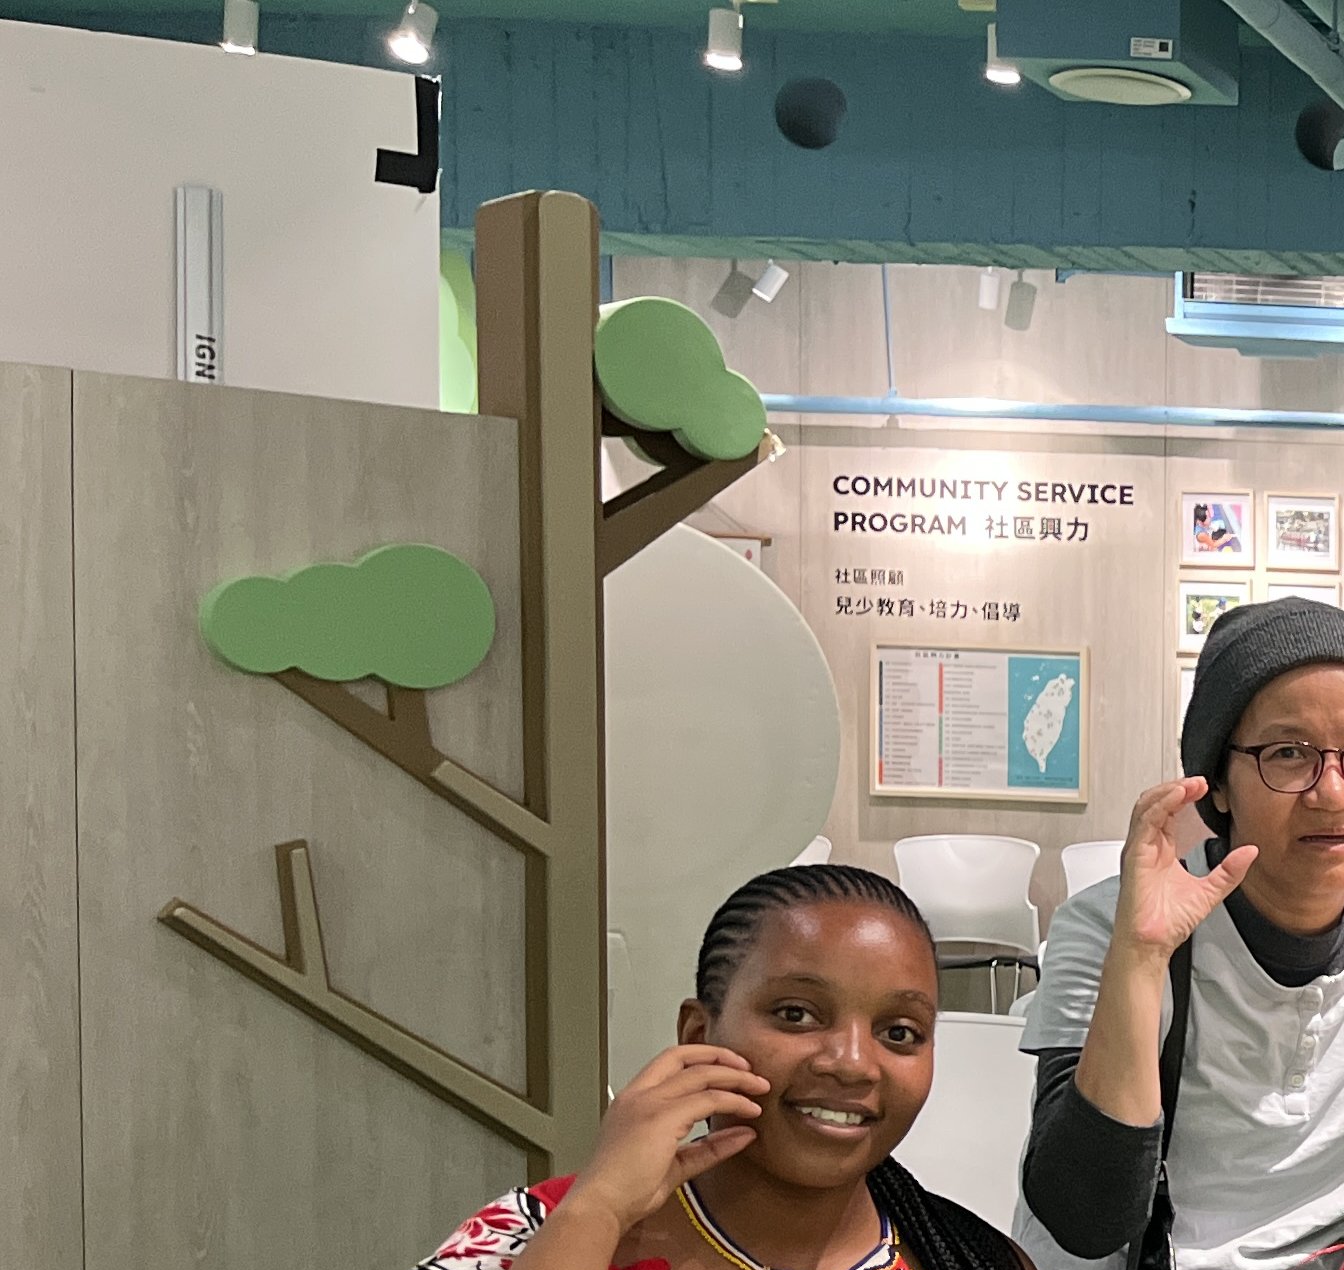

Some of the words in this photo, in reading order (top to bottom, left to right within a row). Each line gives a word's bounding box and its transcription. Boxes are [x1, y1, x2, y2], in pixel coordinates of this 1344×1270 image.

[832, 475, 1008, 500] COMMUNITY
[1016, 481, 1134, 505] SERVICE
[833, 511, 967, 535] PROGRAM
[984, 514, 1089, 542] 社區興力
[835, 567, 904, 586] 社區照顧
